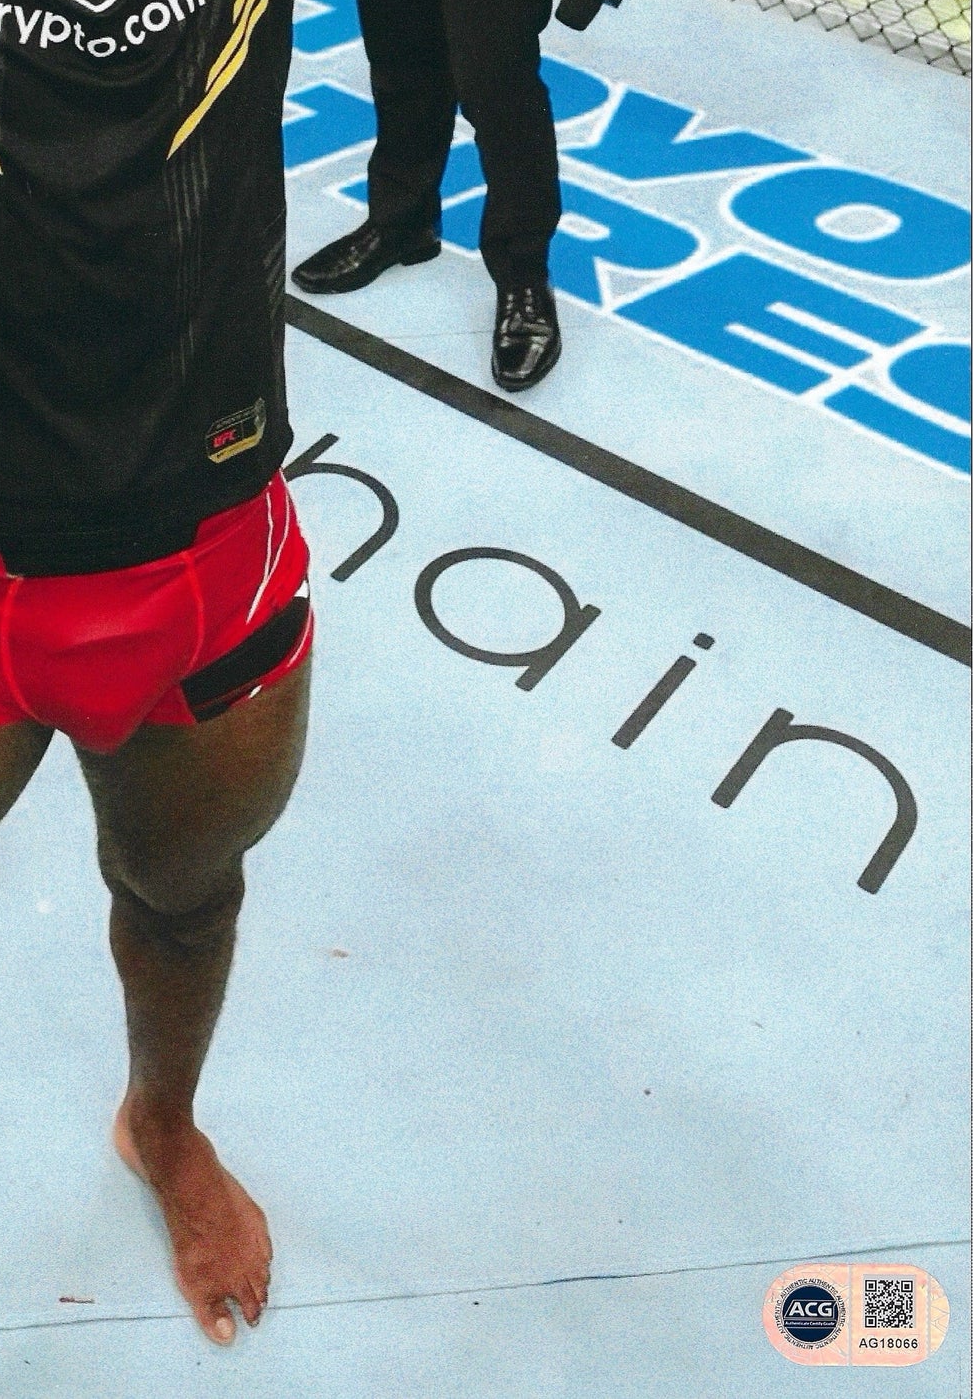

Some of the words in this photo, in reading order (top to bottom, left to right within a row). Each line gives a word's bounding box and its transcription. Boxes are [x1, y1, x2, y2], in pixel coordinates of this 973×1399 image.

[780, 1278, 808, 1299] AUTHENTIC
[808, 1278, 839, 1295] AUTHENTIC
[774, 1300, 786, 1334] AUTHENTIC
[789, 1301, 833, 1317] ACG
[836, 1295, 847, 1327] AUTHENTIC
[784, 1334, 814, 1350] AUTHENTIC
[815, 1328, 842, 1349] AUTHENTIC
[859, 1338, 918, 1349] AG18066
